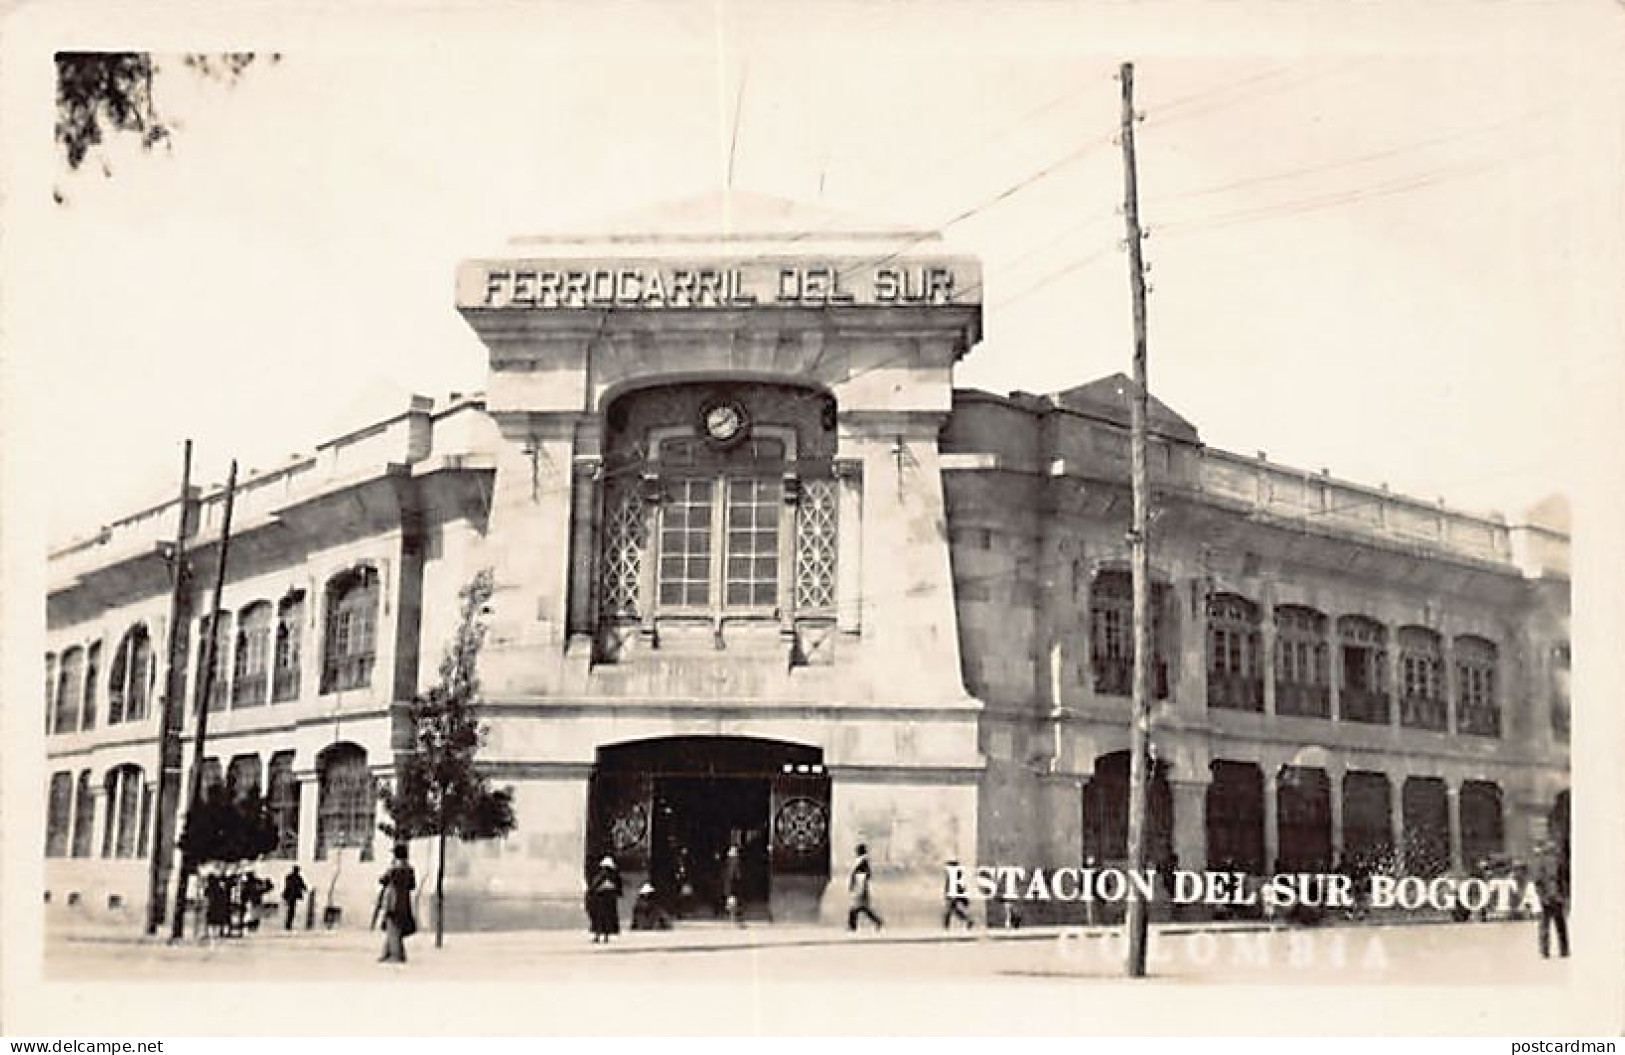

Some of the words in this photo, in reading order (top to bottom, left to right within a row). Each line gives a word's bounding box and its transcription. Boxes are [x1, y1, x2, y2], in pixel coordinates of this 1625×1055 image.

[484, 268, 758, 309] FERROCARRIL
[775, 267, 855, 307] DEL
[874, 267, 956, 307] SUR
